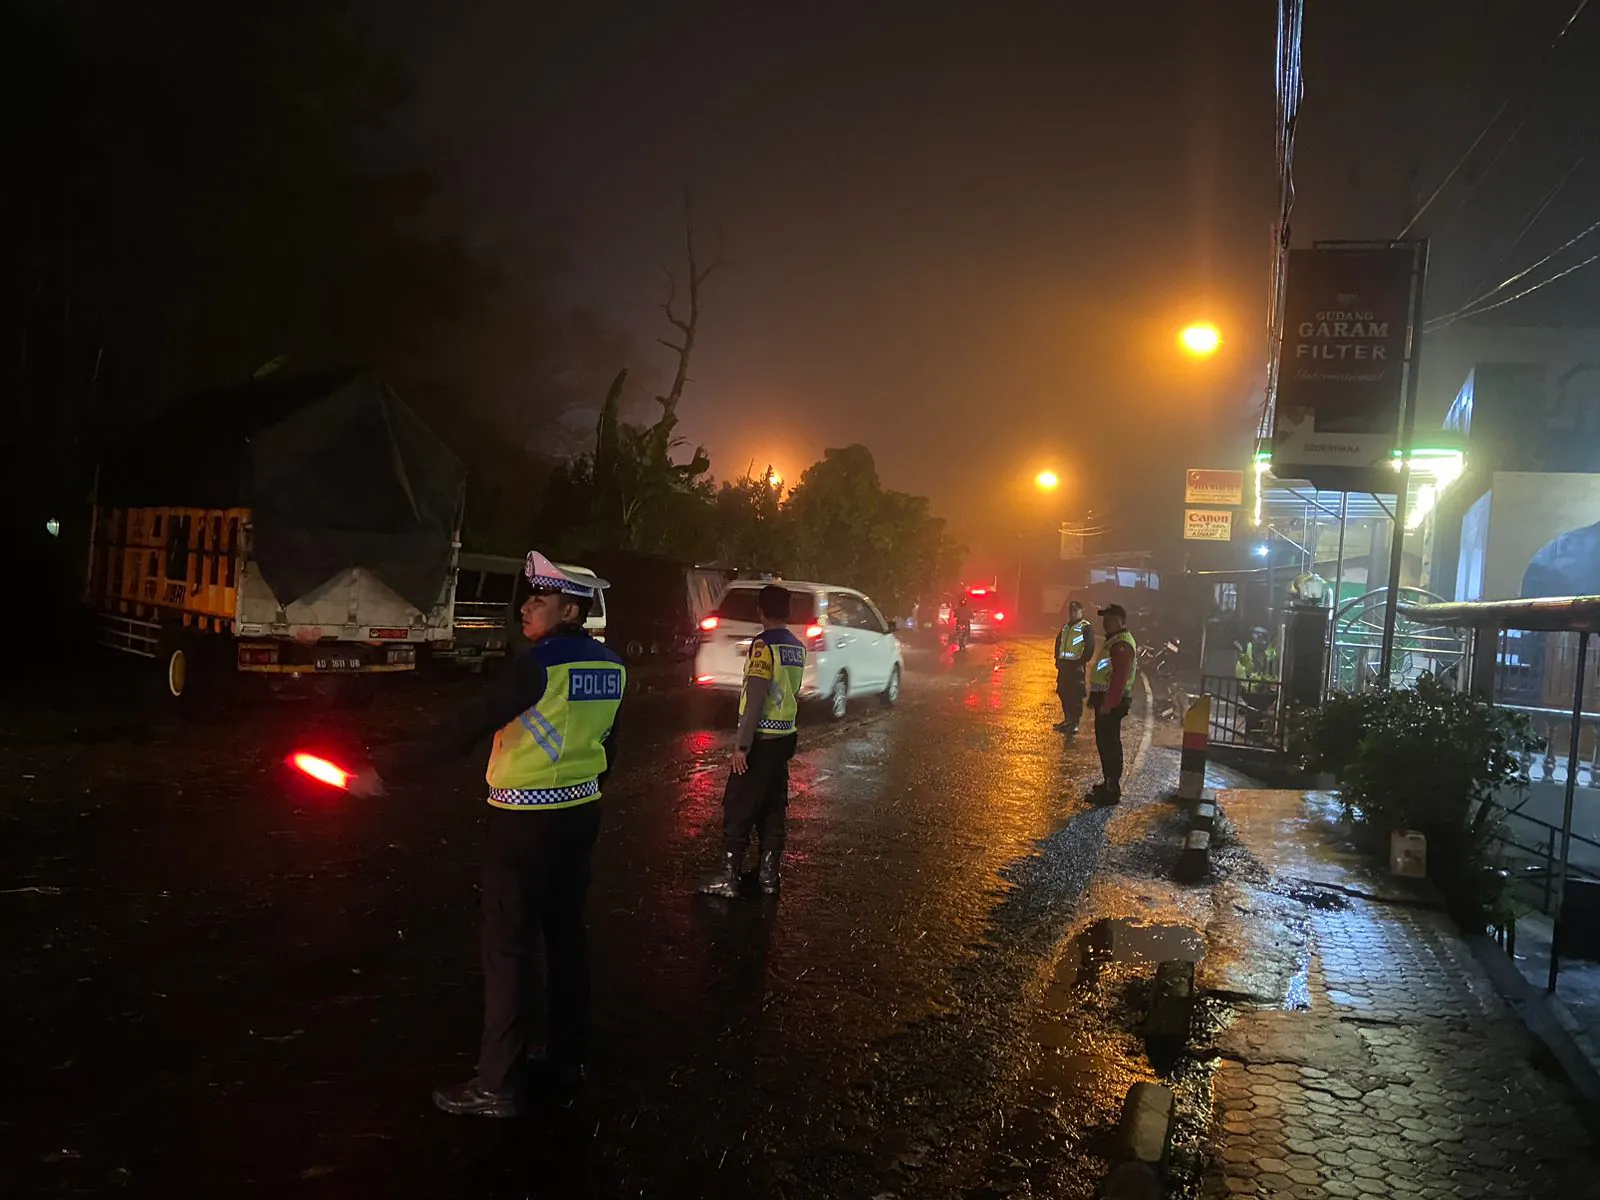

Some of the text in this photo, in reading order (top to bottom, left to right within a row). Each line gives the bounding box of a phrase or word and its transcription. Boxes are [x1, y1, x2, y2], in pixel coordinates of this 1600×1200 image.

[1316, 310, 1375, 321] GUDANG
[1297, 321, 1389, 338] GARAM
[1296, 344, 1387, 360] FILTER
[1188, 513, 1229, 524] Canon
[571, 673, 620, 695] POLISI
